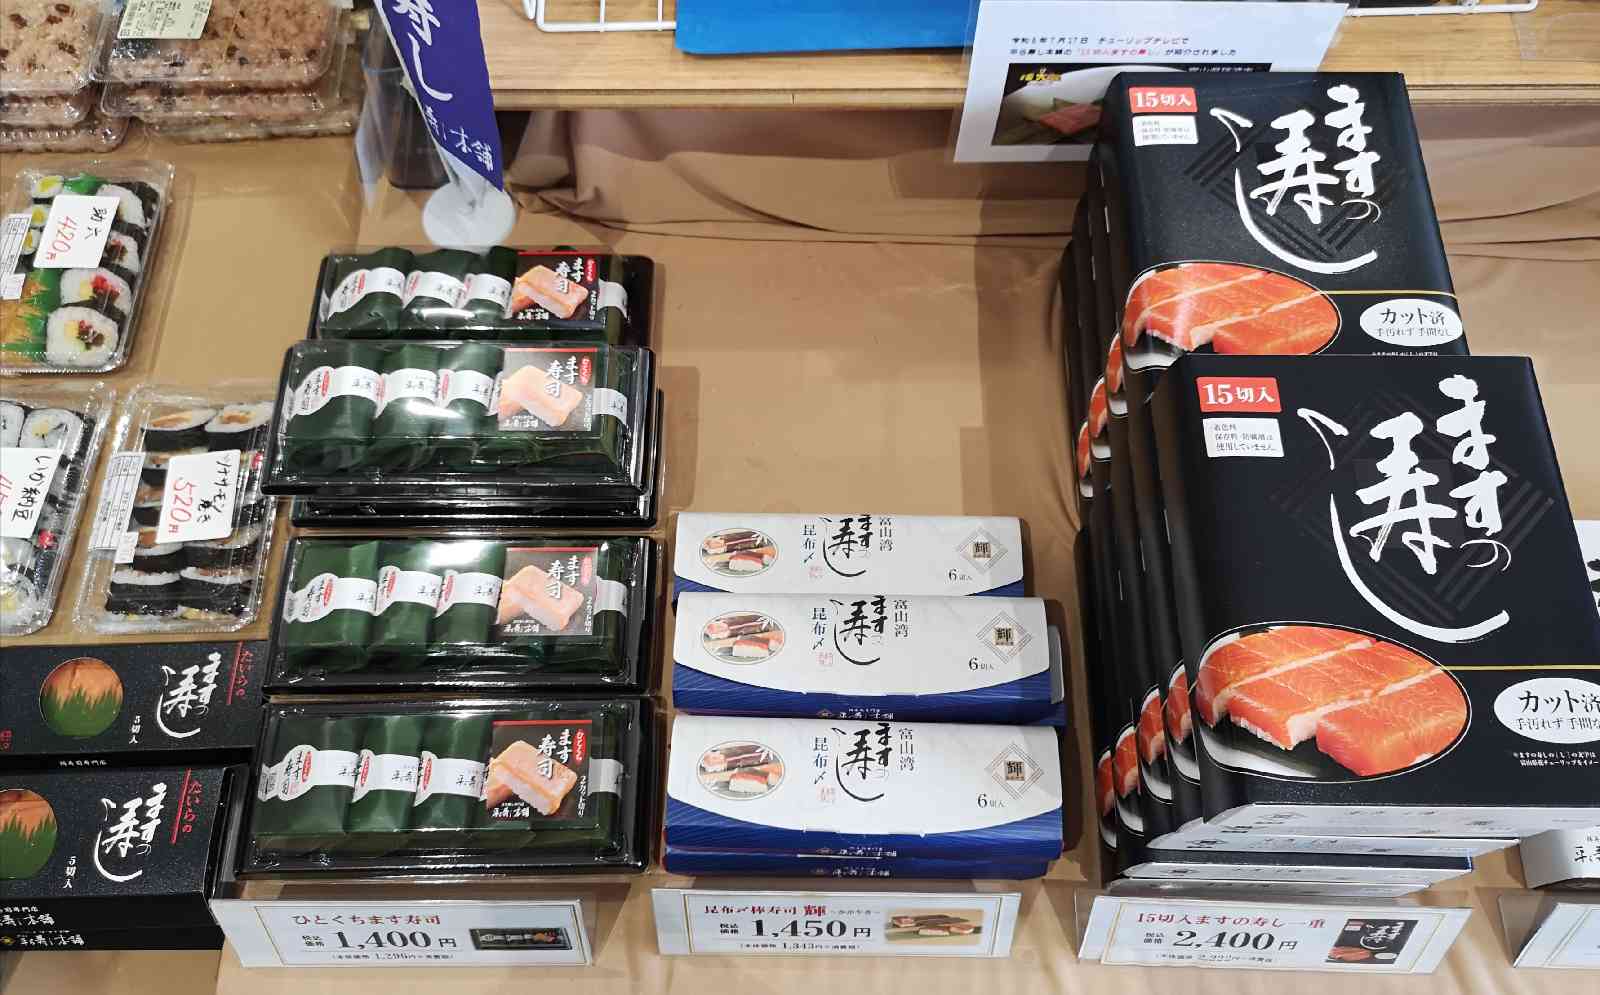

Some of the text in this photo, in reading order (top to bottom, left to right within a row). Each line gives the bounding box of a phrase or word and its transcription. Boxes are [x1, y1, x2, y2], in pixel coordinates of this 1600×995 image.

[1136, 92, 1192, 107] 15切入
[46, 216, 78, 261] 420円
[1380, 307, 1446, 325] カット済
[545, 359, 564, 398] 寿司
[564, 355, 579, 384] ます
[1202, 383, 1275, 405] 15切入
[12, 455, 53, 522] いか納豆
[168, 478, 200, 534] 520円
[544, 559, 565, 598] 寿司
[564, 554, 580, 586] ます
[1516, 717, 1563, 730] 手汚れず
[537, 733, 557, 780] 寿司
[556, 728, 573, 764] ます
[899, 728, 914, 771] 富山湾
[63, 855, 77, 889] 5切入
[291, 914, 441, 925] ひとくちます寿司
